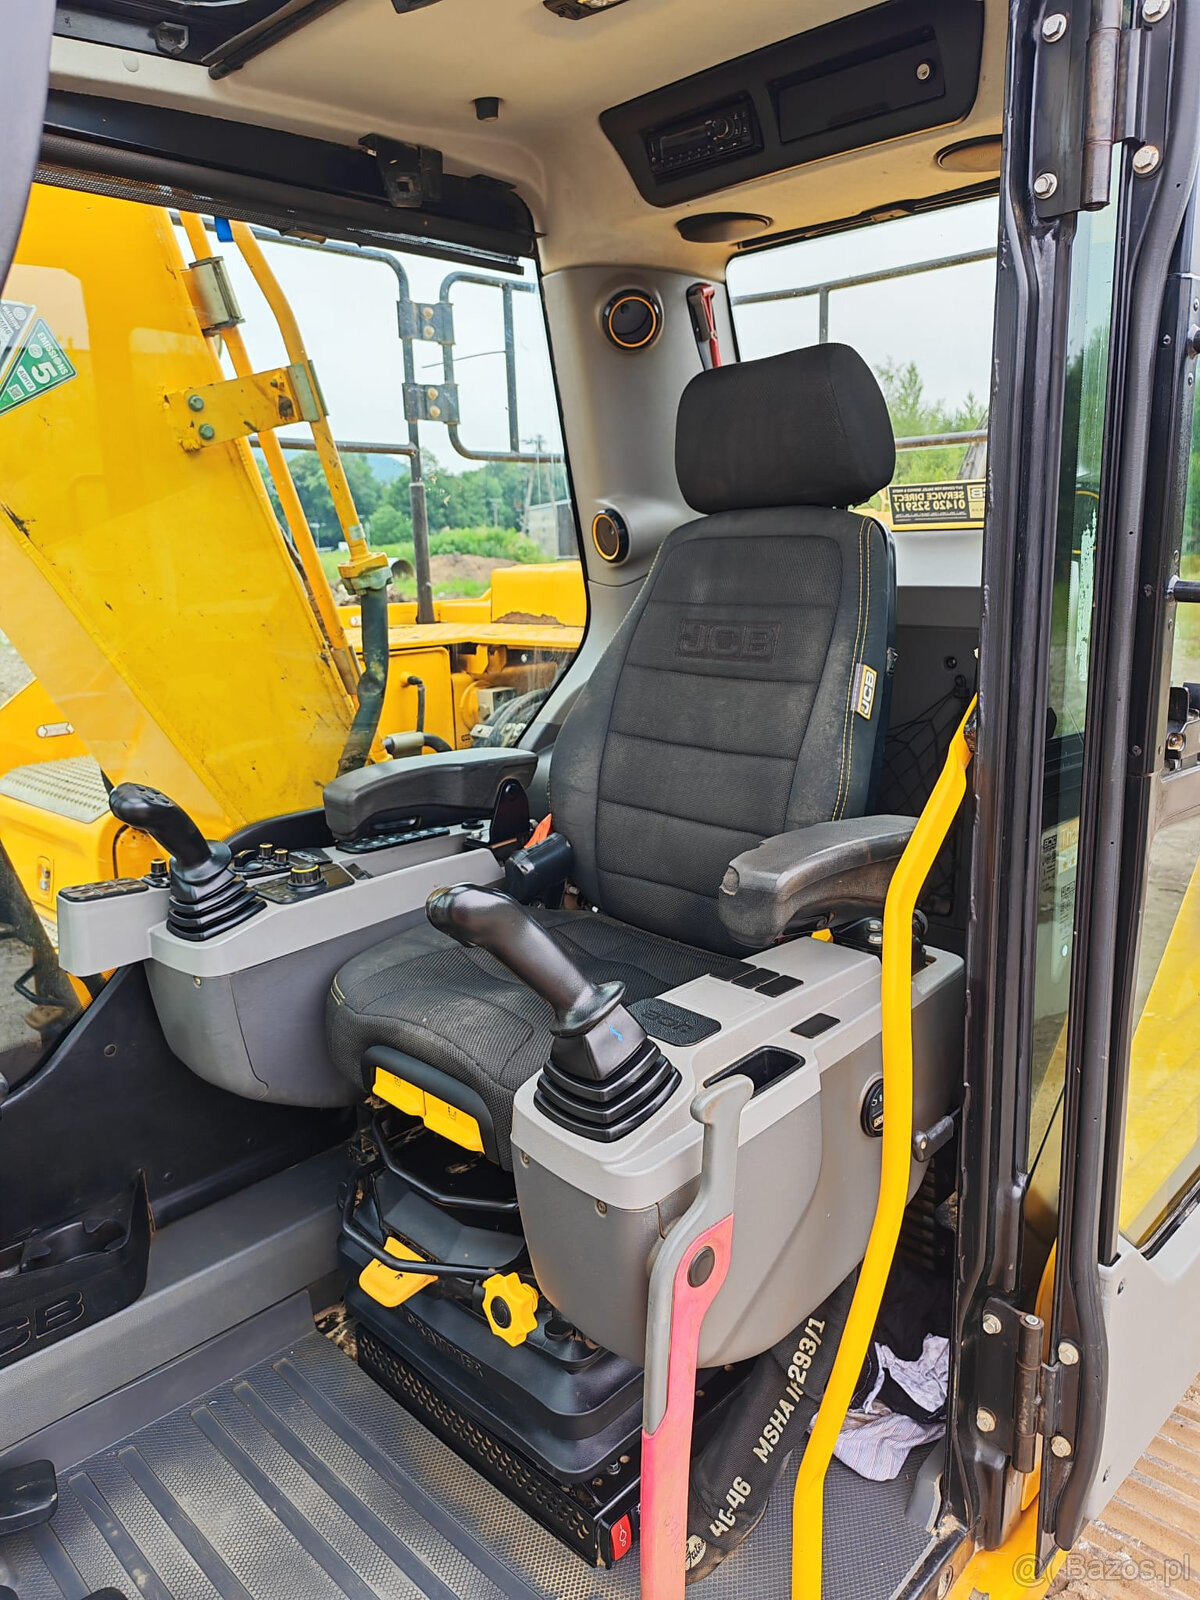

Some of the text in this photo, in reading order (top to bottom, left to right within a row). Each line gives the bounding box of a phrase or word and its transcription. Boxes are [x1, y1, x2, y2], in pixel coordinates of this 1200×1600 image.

[31, 361, 59, 384] 5
[37, 332, 69, 375] EMISSIONS
[679, 622, 777, 658] JCB
[861, 670, 876, 715] JCB
[752, 1399, 795, 1463] MSHA
